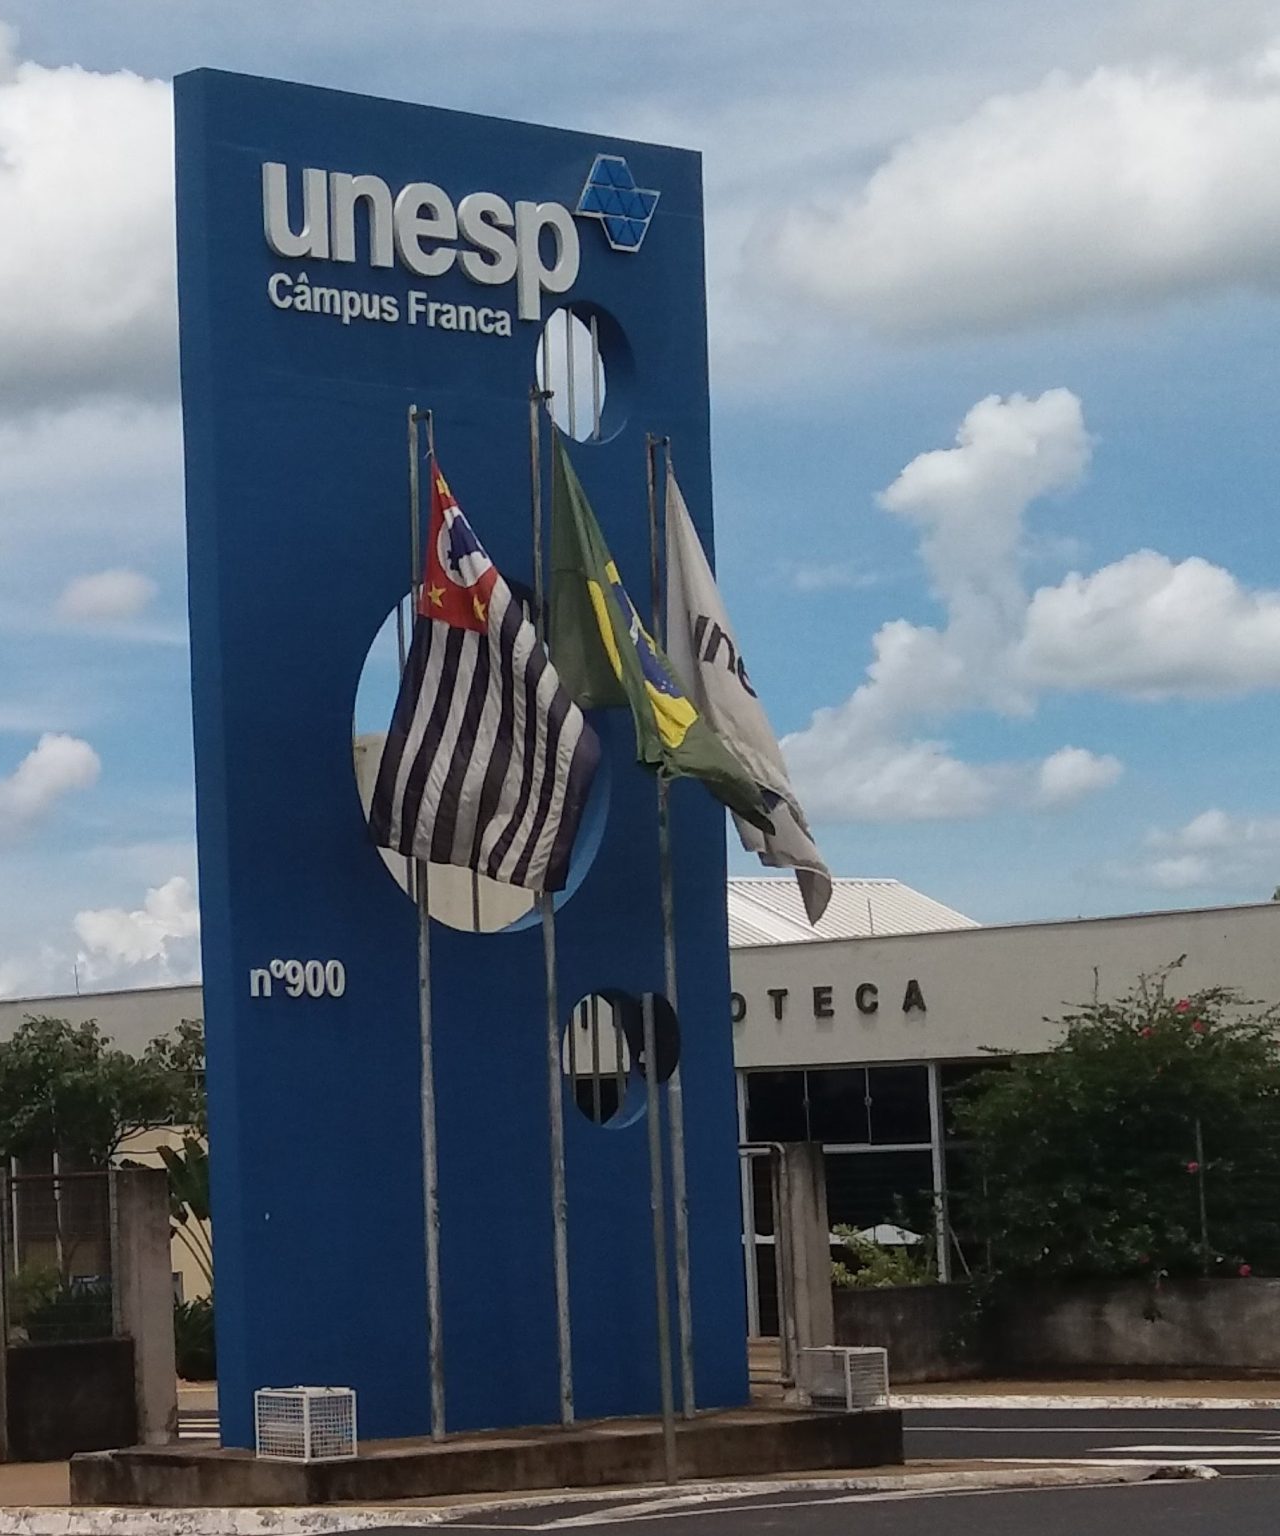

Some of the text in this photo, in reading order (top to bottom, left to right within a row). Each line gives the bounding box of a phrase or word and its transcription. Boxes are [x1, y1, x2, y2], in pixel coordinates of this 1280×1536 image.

[262, 161, 581, 321] unesp
[268, 271, 513, 337] Câmpus Franca
